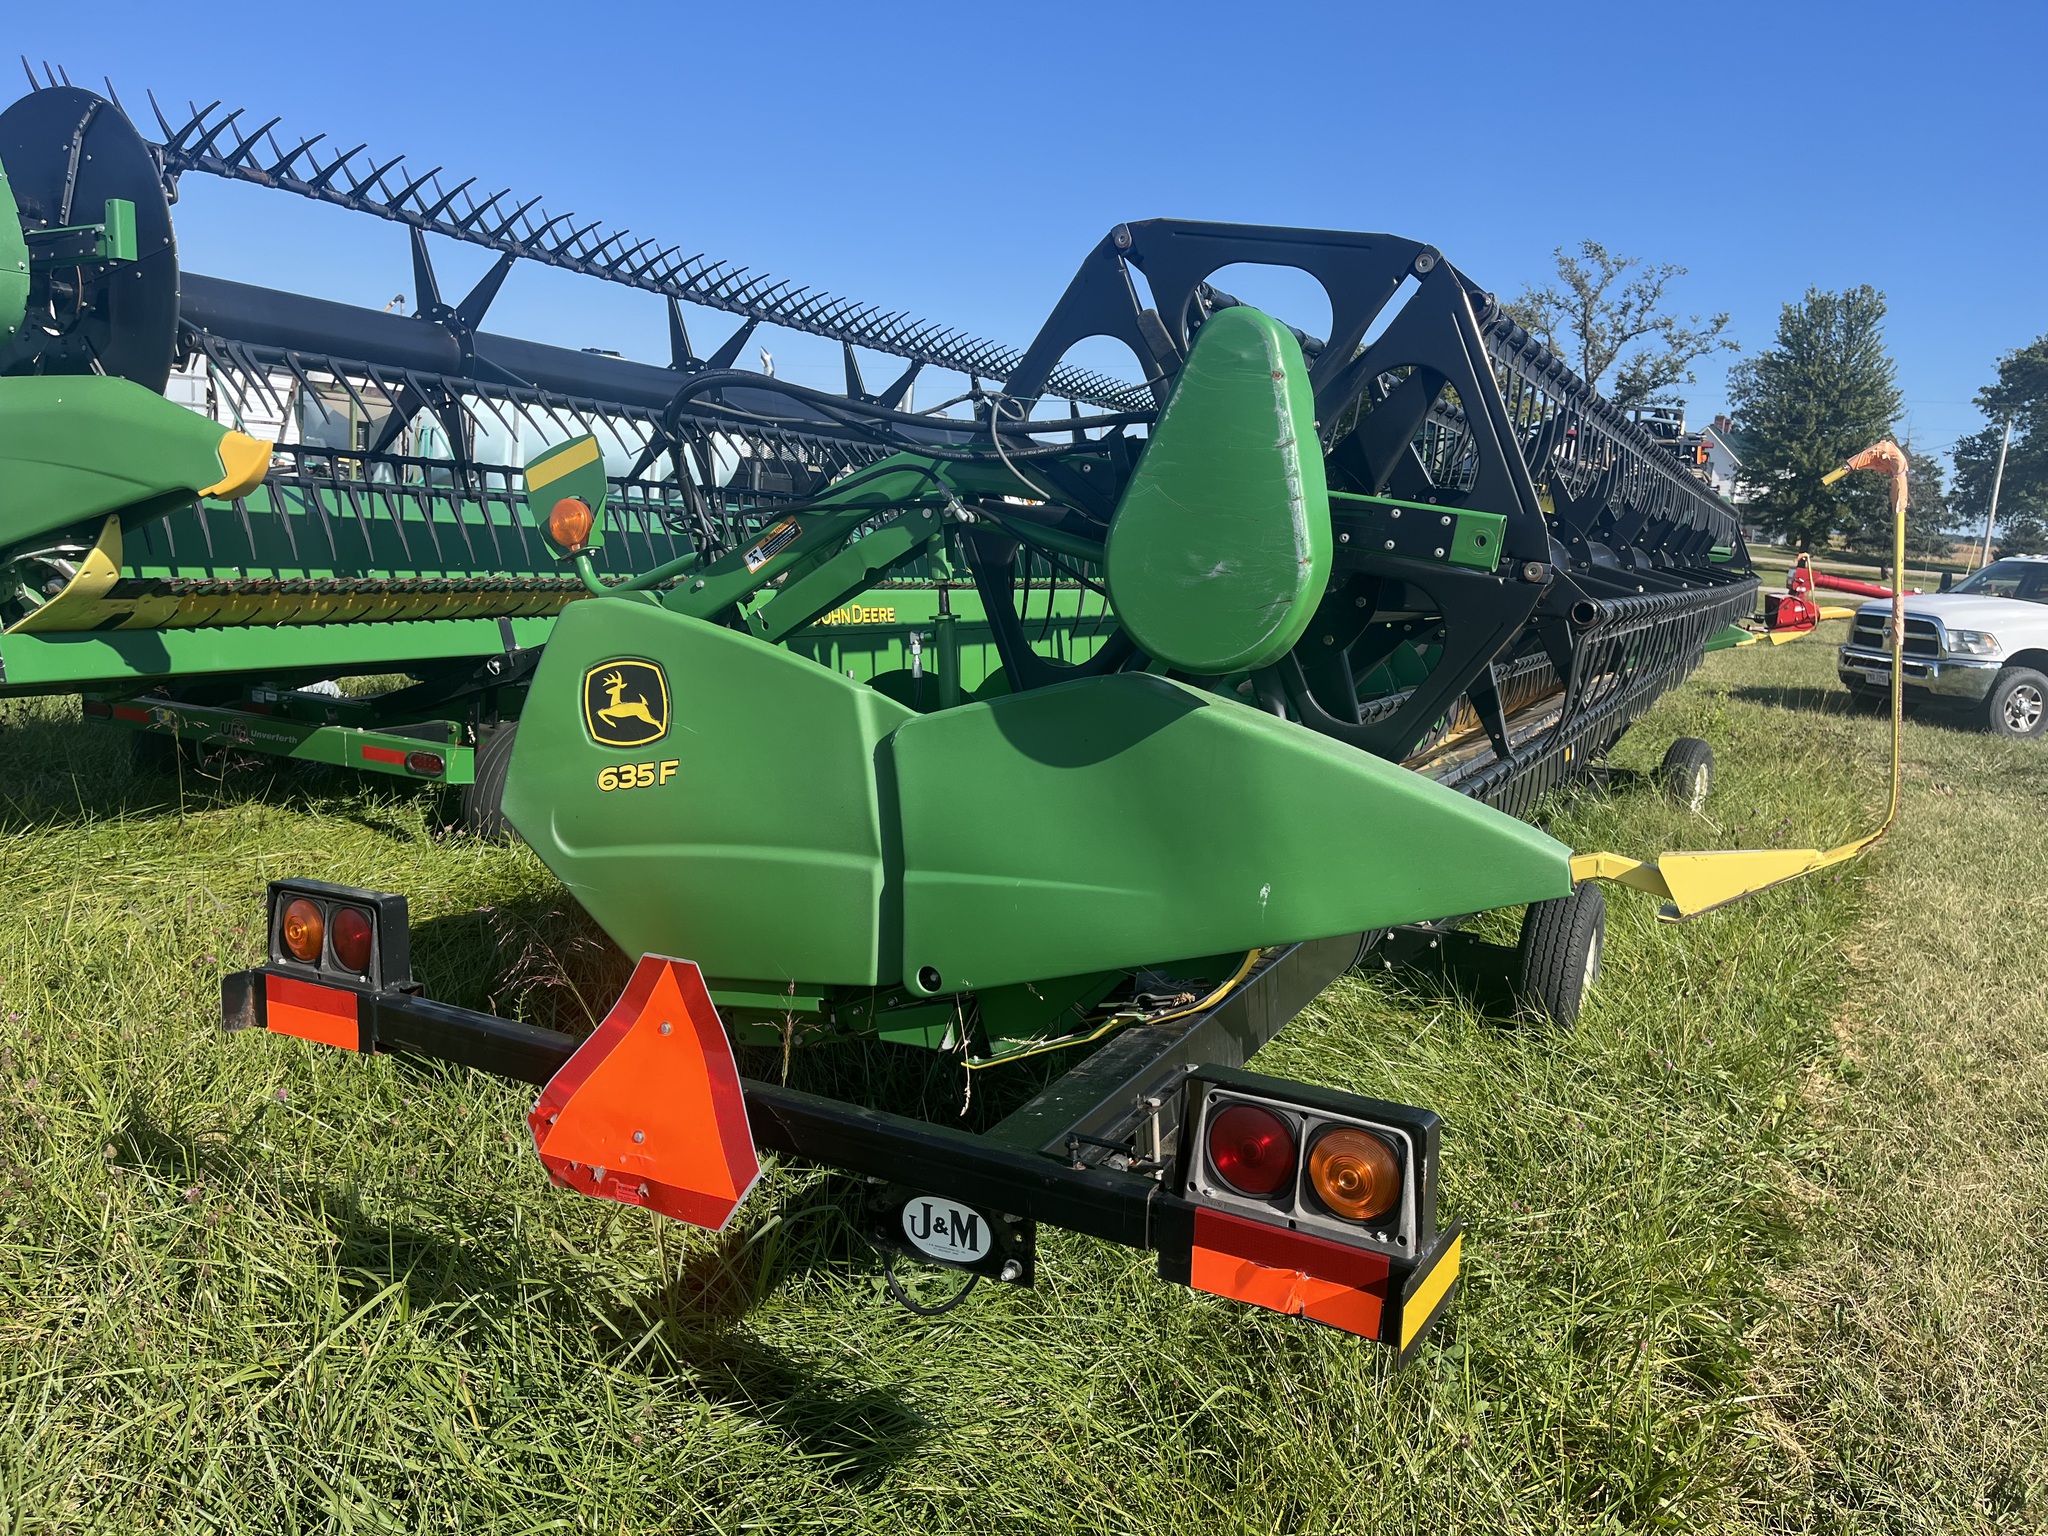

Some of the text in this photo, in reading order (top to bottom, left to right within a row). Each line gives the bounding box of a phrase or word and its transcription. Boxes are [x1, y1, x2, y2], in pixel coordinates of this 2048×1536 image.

[812, 603, 896, 627] OHN DEERE
[250, 728, 298, 745] Unverferth
[597, 758, 680, 793] 635 F
[908, 1202, 981, 1253] J&M
